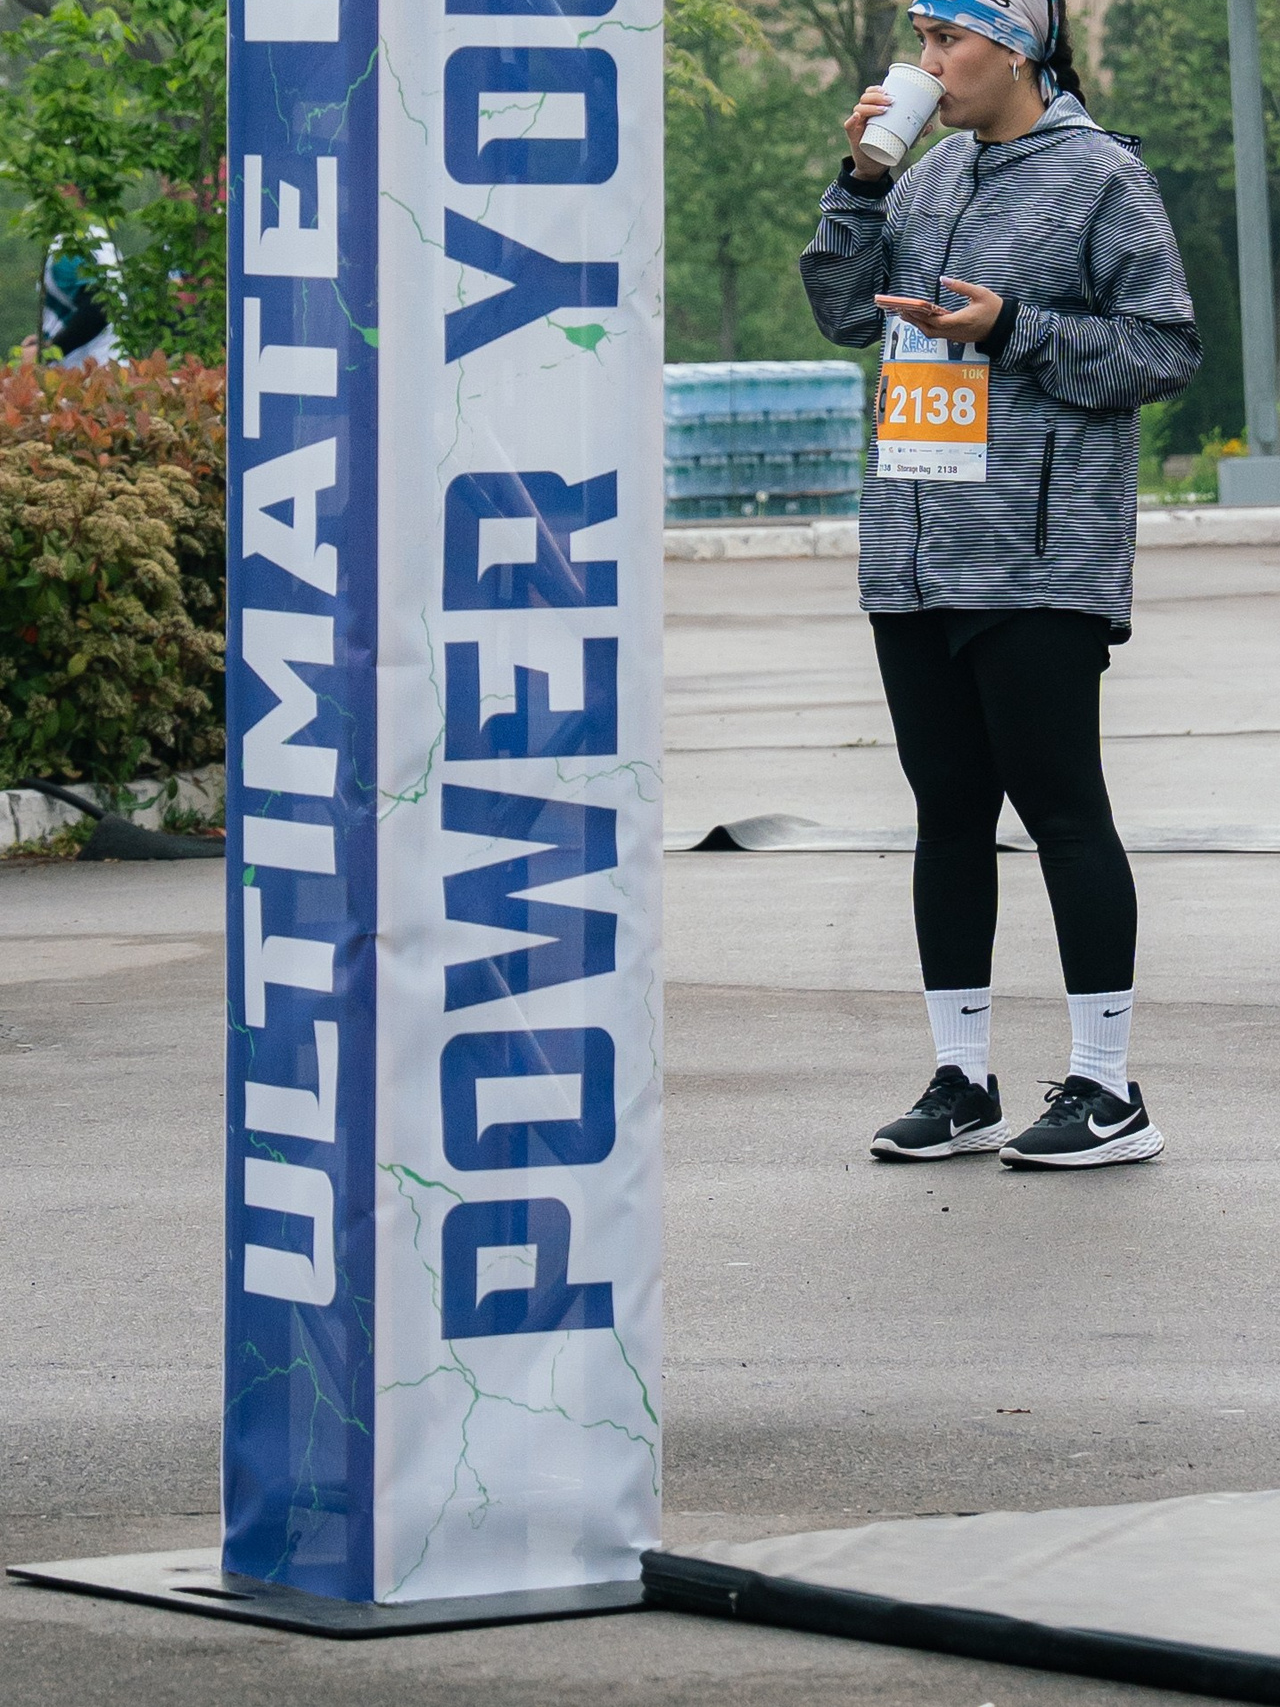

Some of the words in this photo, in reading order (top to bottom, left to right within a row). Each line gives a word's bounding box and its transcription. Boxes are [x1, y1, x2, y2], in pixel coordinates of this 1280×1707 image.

[962, 368, 985, 379] 10K
[889, 385, 976, 426] 2138
[897, 464, 918, 475] Storage
[918, 465, 931, 475] Bag
[937, 465, 958, 474] 2138
[242, 154, 340, 1307] ULTIMATE
[440, 470, 619, 1340] POWER
